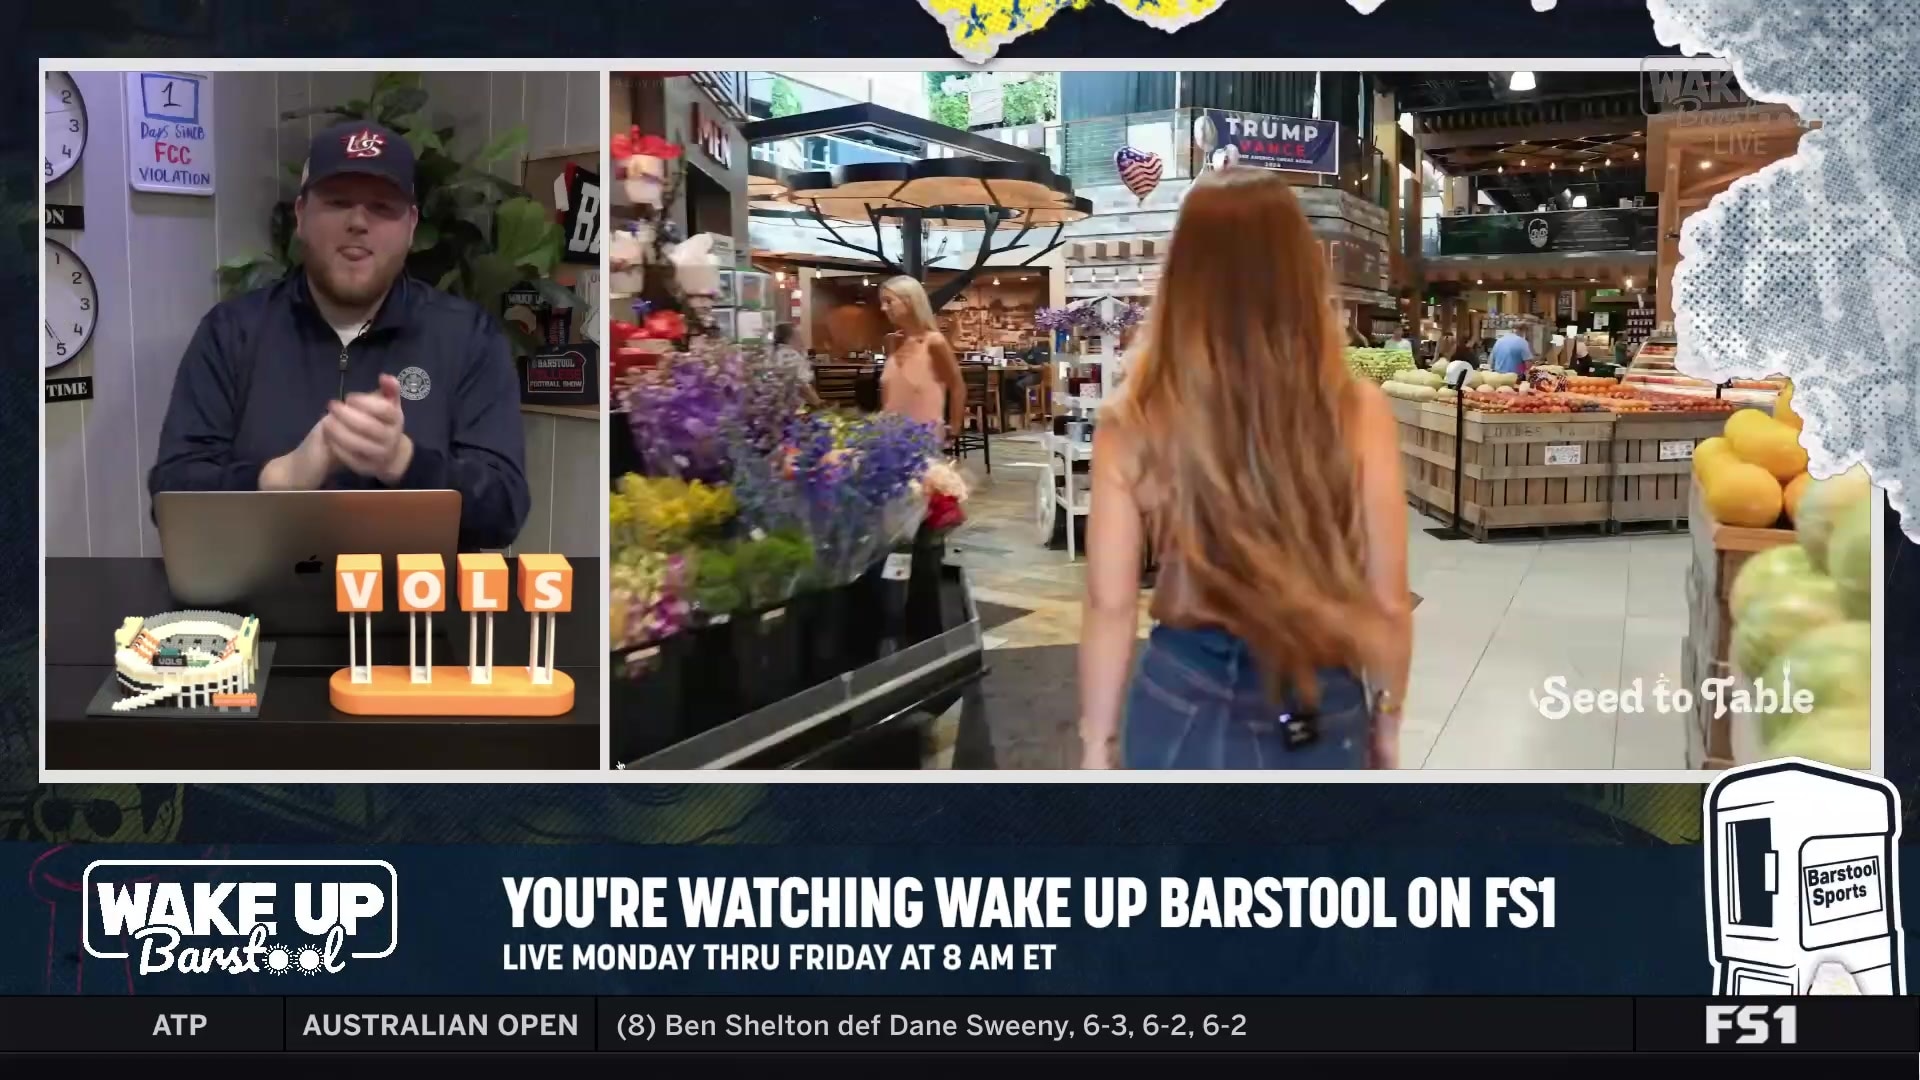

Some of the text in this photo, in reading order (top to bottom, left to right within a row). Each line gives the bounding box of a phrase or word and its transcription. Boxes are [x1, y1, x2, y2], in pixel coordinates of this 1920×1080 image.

[61, 90, 72, 104] 2
[161, 81, 182, 107] 1
[68, 119, 80, 133] 3
[1225, 117, 1318, 142] TRUMP
[62, 144, 71, 158] 4
[155, 142, 192, 165] FCC
[1240, 140, 1305, 157] VANCE
[139, 167, 210, 185] VIOLATION
[55, 252, 60, 265] 1
[71, 271, 82, 285] 2
[80, 297, 90, 310] 3
[74, 323, 83, 336] 4
[56, 342, 66, 356] 5
[537, 358, 575, 368] BARSTOOL
[46, 382, 88, 398] TIME
[529, 380, 582, 388] FOOTBALL SHOW
[340, 571, 563, 609] VOLS
